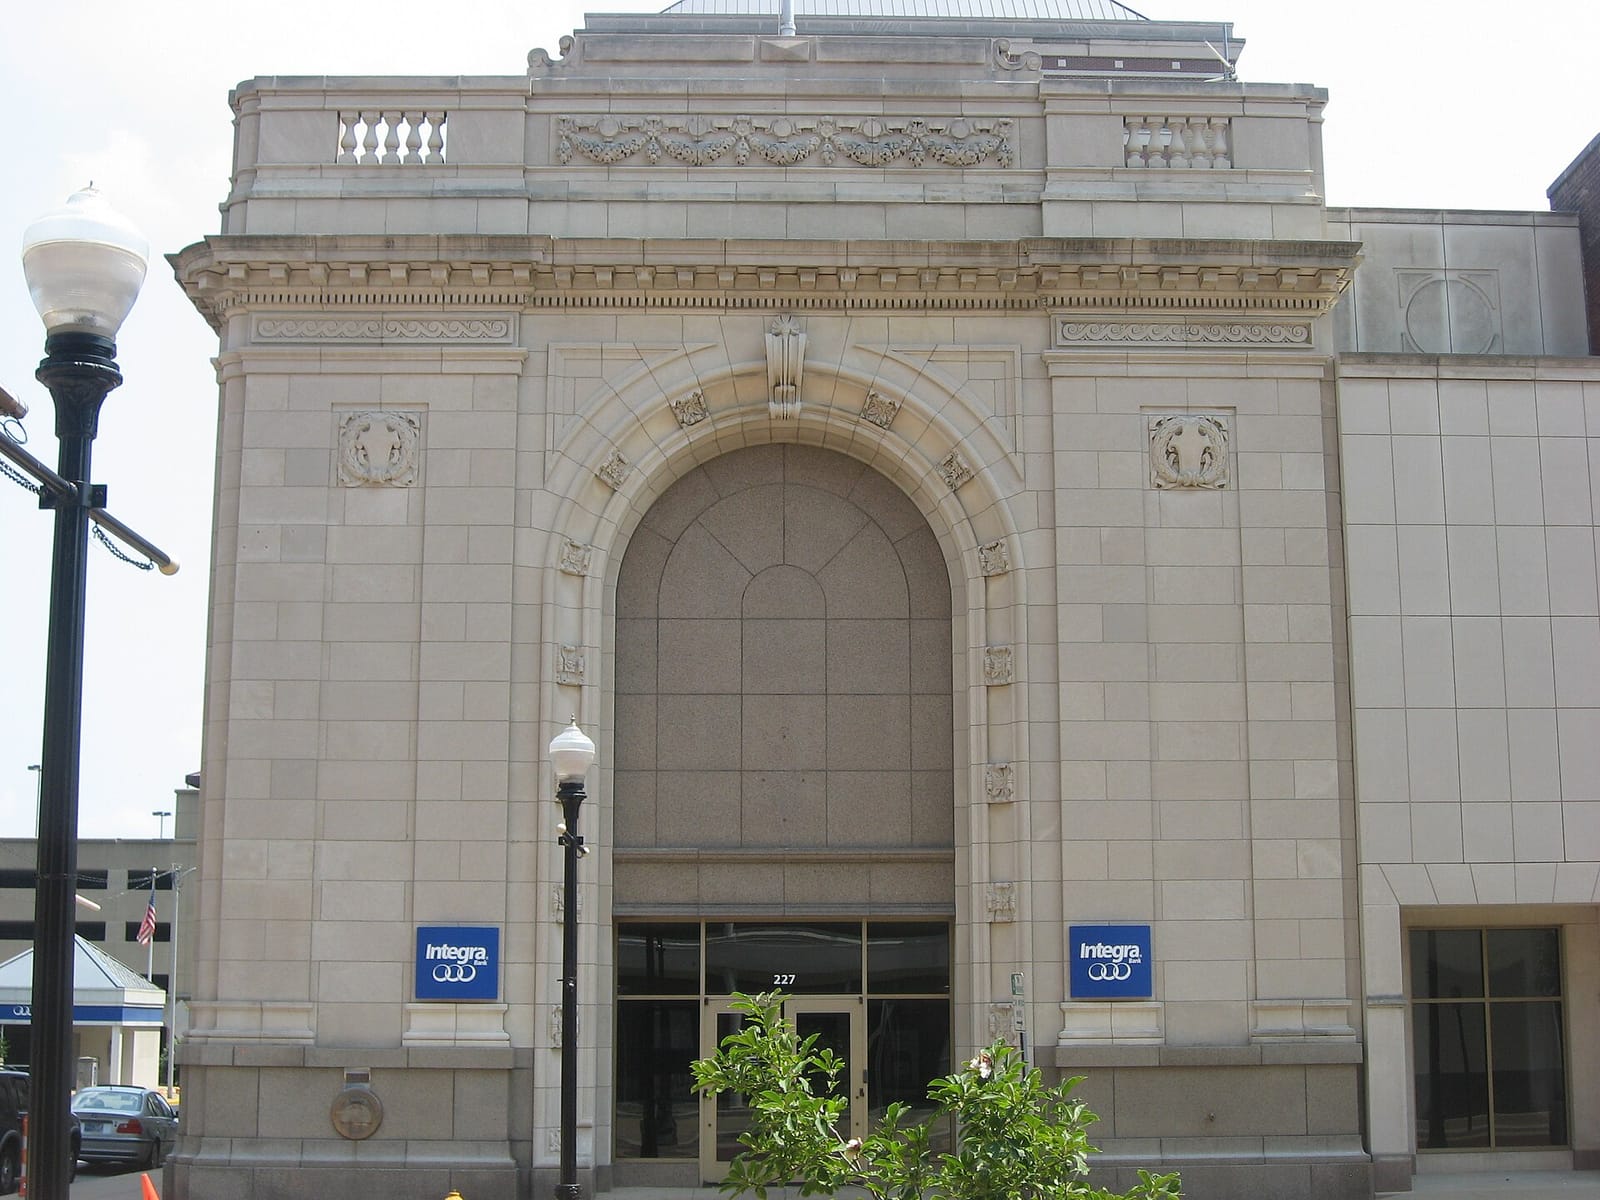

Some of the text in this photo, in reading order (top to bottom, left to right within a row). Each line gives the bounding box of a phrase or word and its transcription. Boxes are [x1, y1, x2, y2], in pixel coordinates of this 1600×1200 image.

[426, 944, 487, 965] Integra
[1080, 943, 1141, 963] Integra
[773, 974, 796, 985] 227
